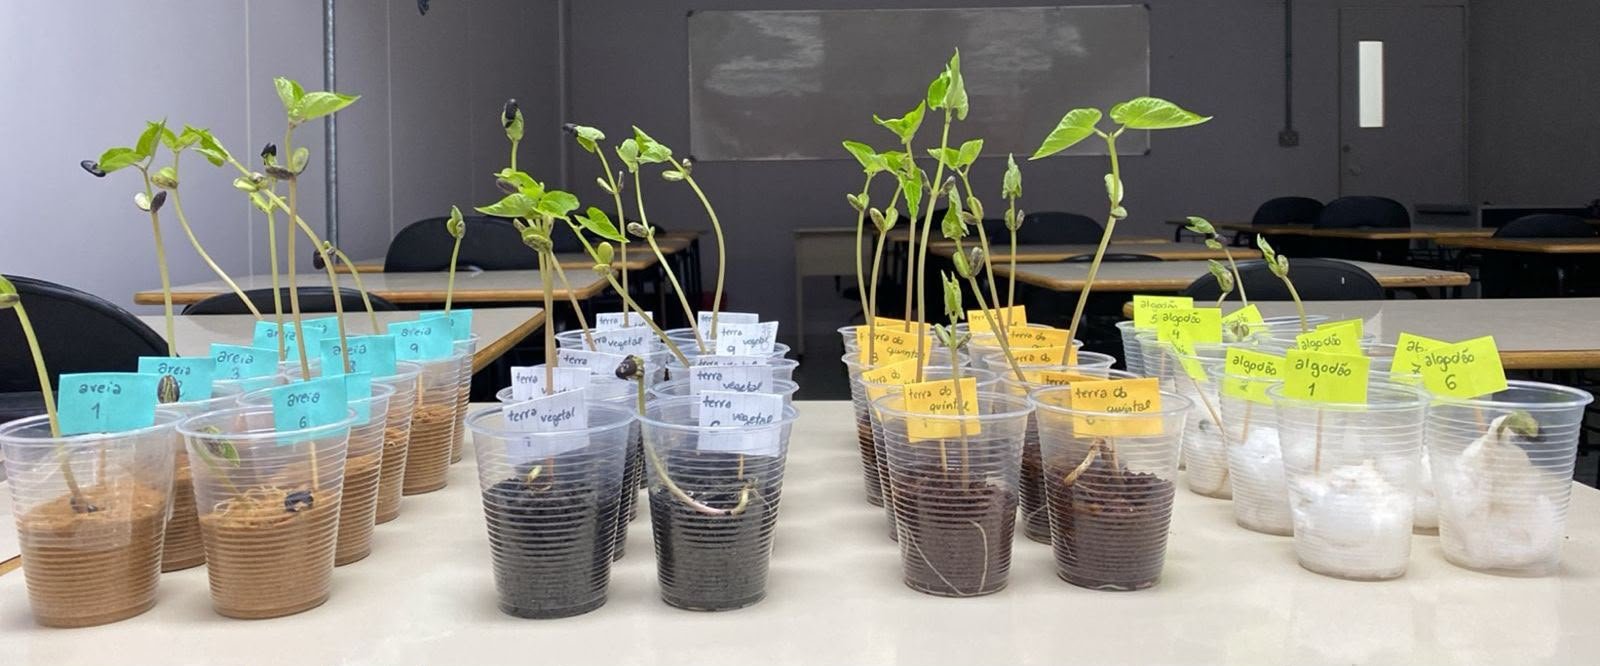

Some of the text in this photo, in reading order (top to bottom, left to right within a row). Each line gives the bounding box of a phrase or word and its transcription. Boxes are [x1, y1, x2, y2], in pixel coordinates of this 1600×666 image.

[1162, 311, 1202, 327] algodão
[266, 328, 296, 341] aria
[401, 326, 432, 337] areia
[721, 327, 743, 337] terra
[859, 332, 890, 342] trra
[409, 342, 419, 353] 9
[1301, 333, 1341, 351] algodão
[332, 344, 367, 356] aeia
[726, 345, 736, 356] 9
[217, 350, 254, 365] areia
[563, 354, 588, 365] terra
[1013, 353, 1034, 362] erra
[1425, 348, 1475, 372] algodão
[158, 361, 191, 376] areia
[1232, 355, 1277, 375] algodão
[1295, 358, 1352, 378] algodão
[231, 366, 241, 380] 3
[516, 373, 538, 384] terra
[696, 371, 723, 382] terra
[78, 381, 122, 395] areia
[1445, 373, 1457, 391] 6
[908, 385, 952, 399] terra do
[1075, 386, 1128, 399] terra do
[1307, 382, 1316, 397] 1
[287, 390, 321, 407] areia
[702, 395, 732, 409] terra
[91, 402, 101, 420] 1
[929, 398, 970, 415] quintl
[299, 415, 309, 430] 6
[507, 406, 576, 427] terra vegetal
